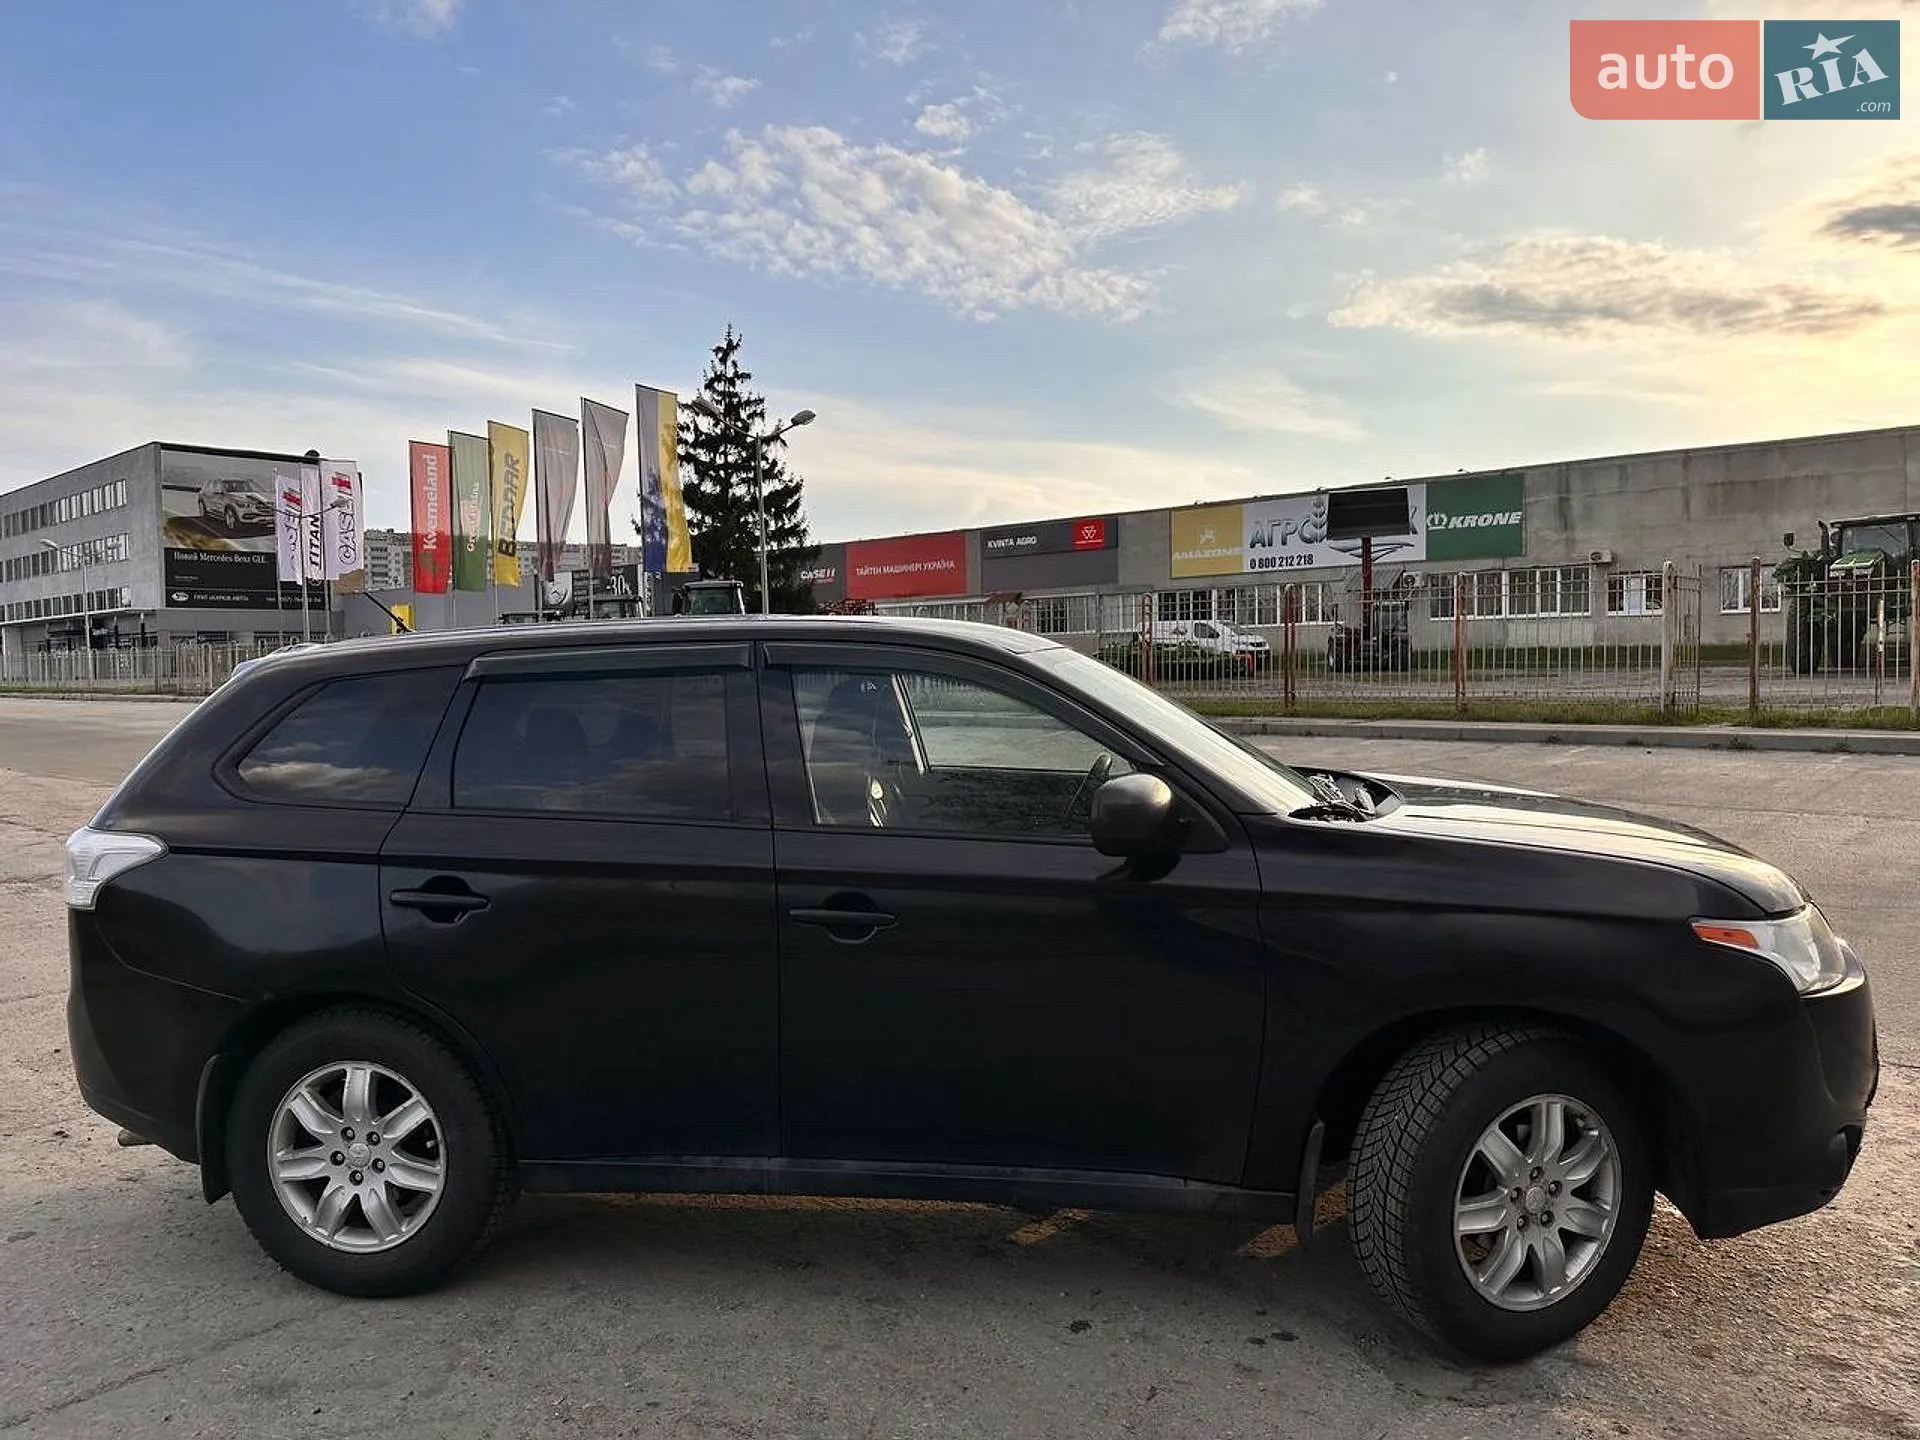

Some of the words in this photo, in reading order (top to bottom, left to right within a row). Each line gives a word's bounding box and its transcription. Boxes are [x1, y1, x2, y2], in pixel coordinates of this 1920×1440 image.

[1448, 511, 1522, 529] KRONE
[308, 514, 320, 567] TITAN
[1250, 558, 1257, 569] 0
[1258, 556, 1277, 569] 800
[1278, 555, 1294, 568] 212
[1296, 553, 1314, 566] 218
[800, 568, 825, 580] CASE
